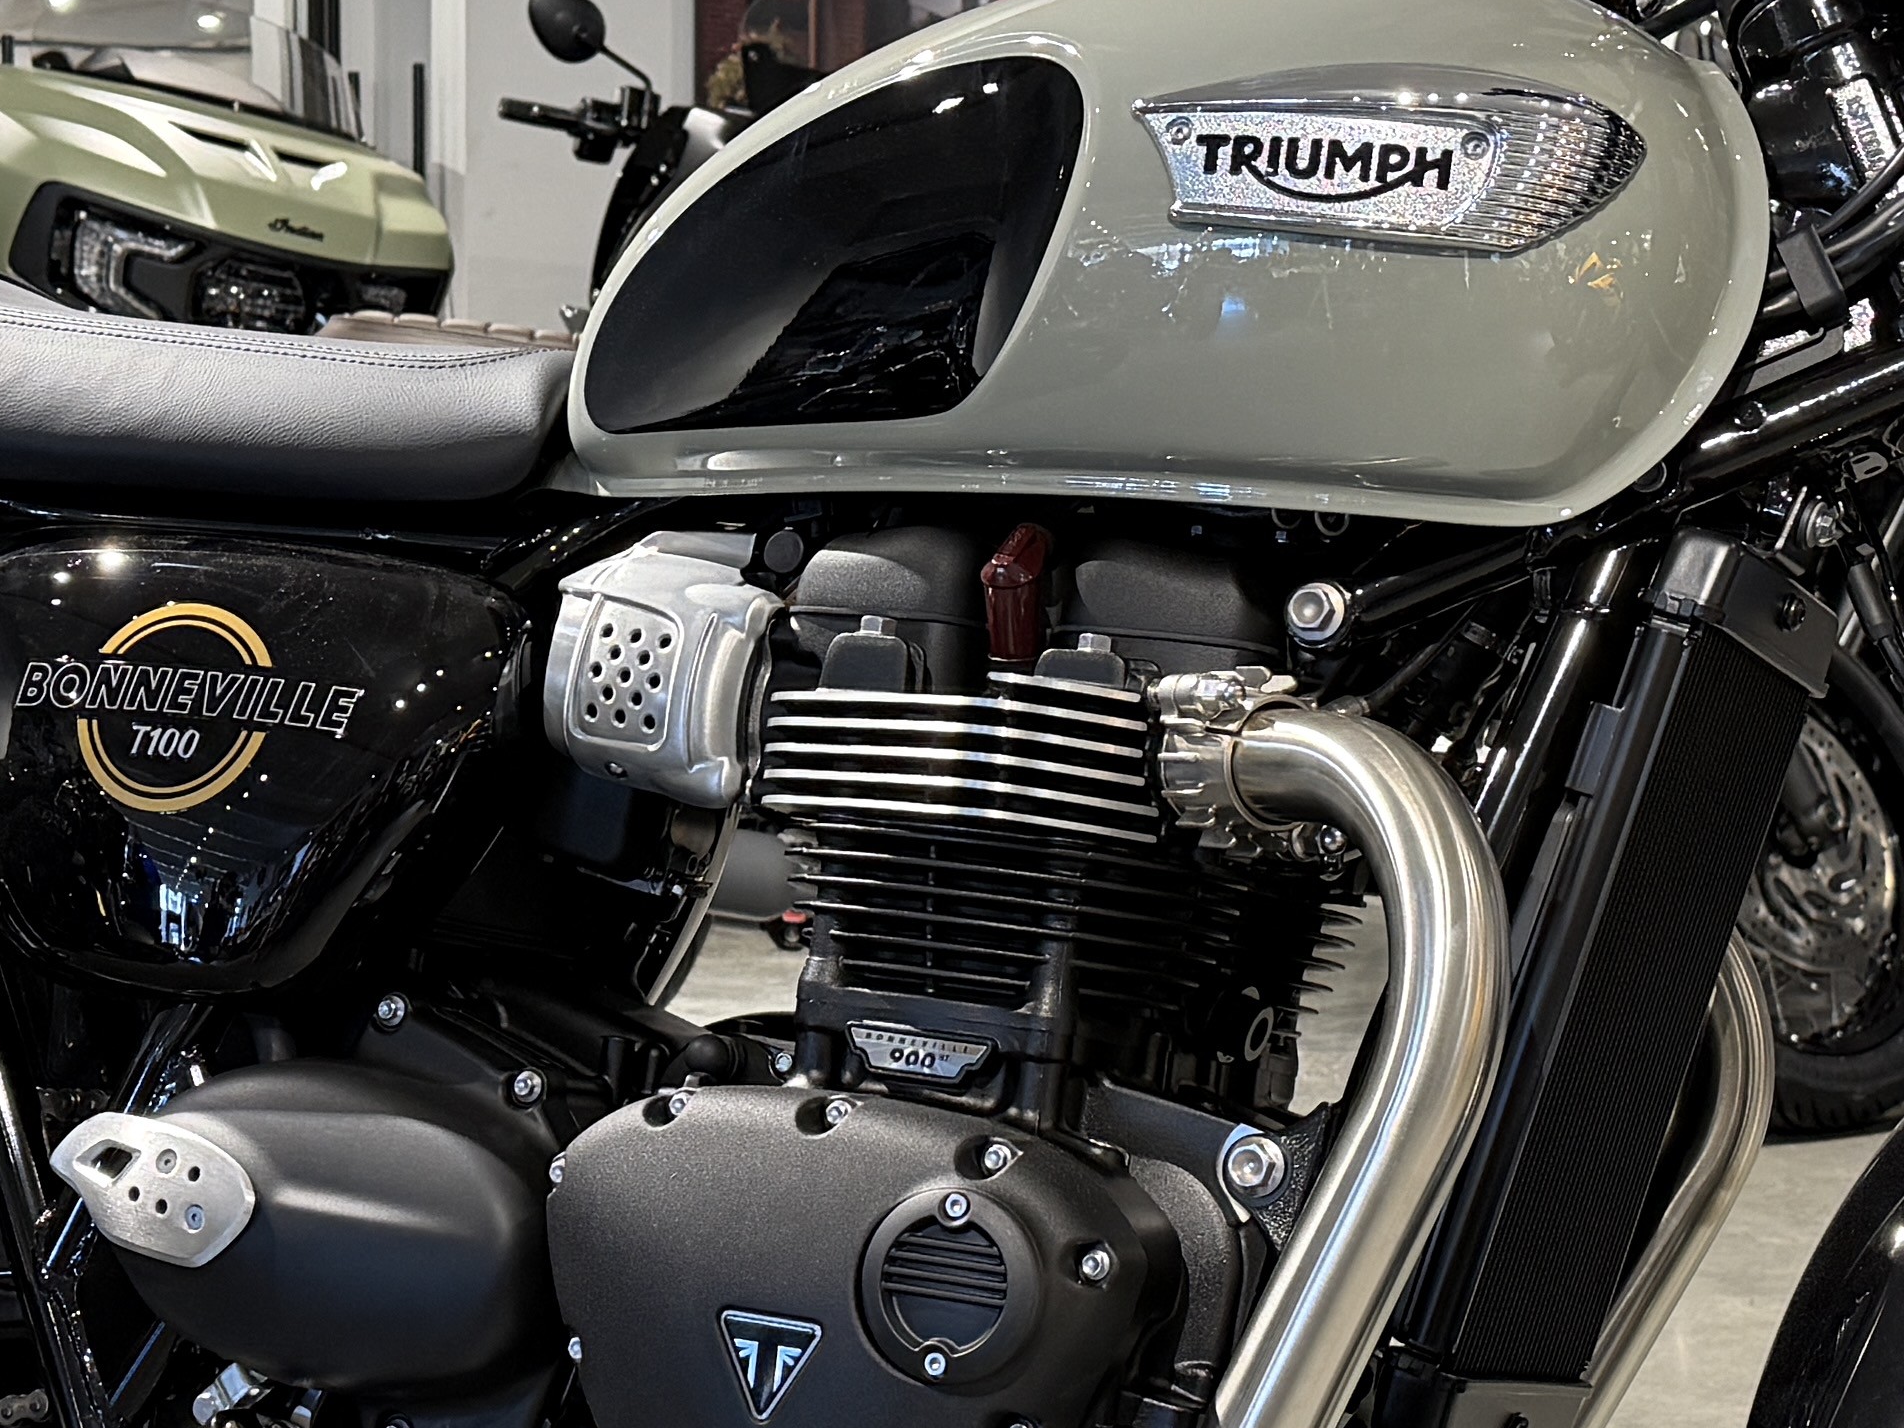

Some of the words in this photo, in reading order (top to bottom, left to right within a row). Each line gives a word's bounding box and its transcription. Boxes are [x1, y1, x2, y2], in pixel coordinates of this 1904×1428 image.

[1196, 133, 1454, 203] TRIUMPH
[15, 660, 366, 733] BONNEVILLE
[129, 724, 201, 760] T100
[889, 1047, 937, 1069] 900
